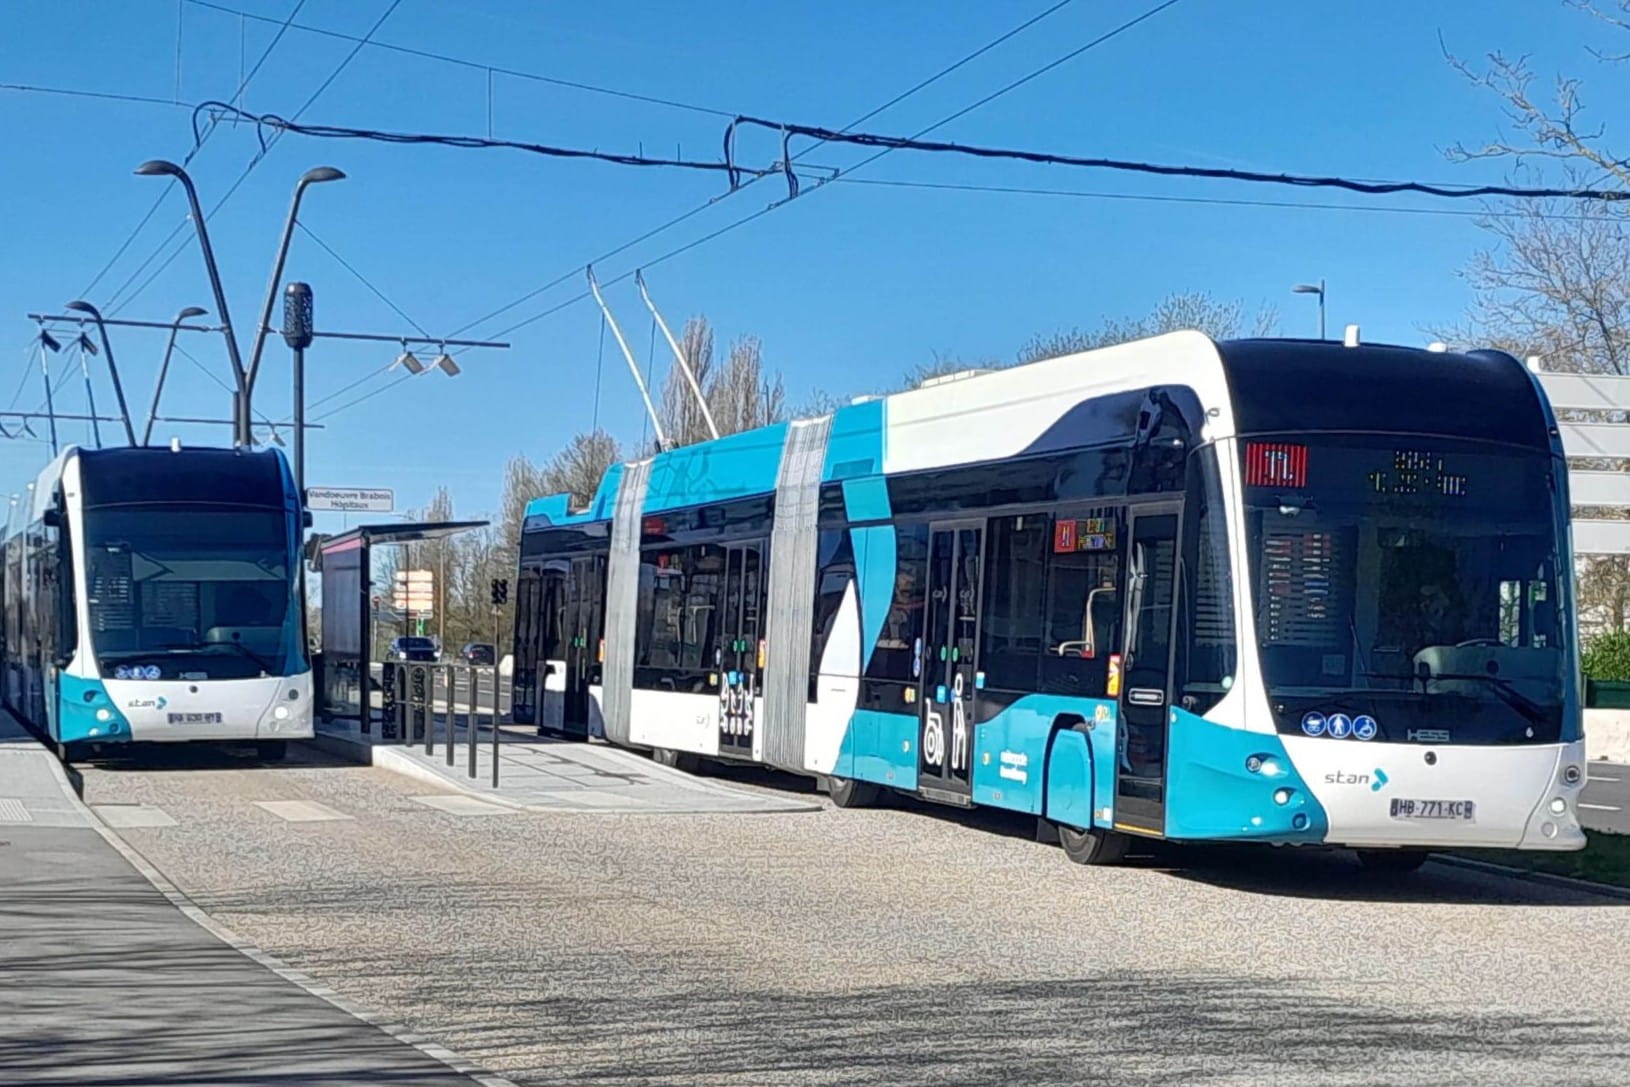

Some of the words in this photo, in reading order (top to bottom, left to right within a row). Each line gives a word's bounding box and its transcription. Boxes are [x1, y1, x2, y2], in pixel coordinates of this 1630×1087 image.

[1407, 729, 1450, 742] HESS
[1324, 769, 1370, 785] stan
[1399, 800, 1464, 817] HB-771-KC
